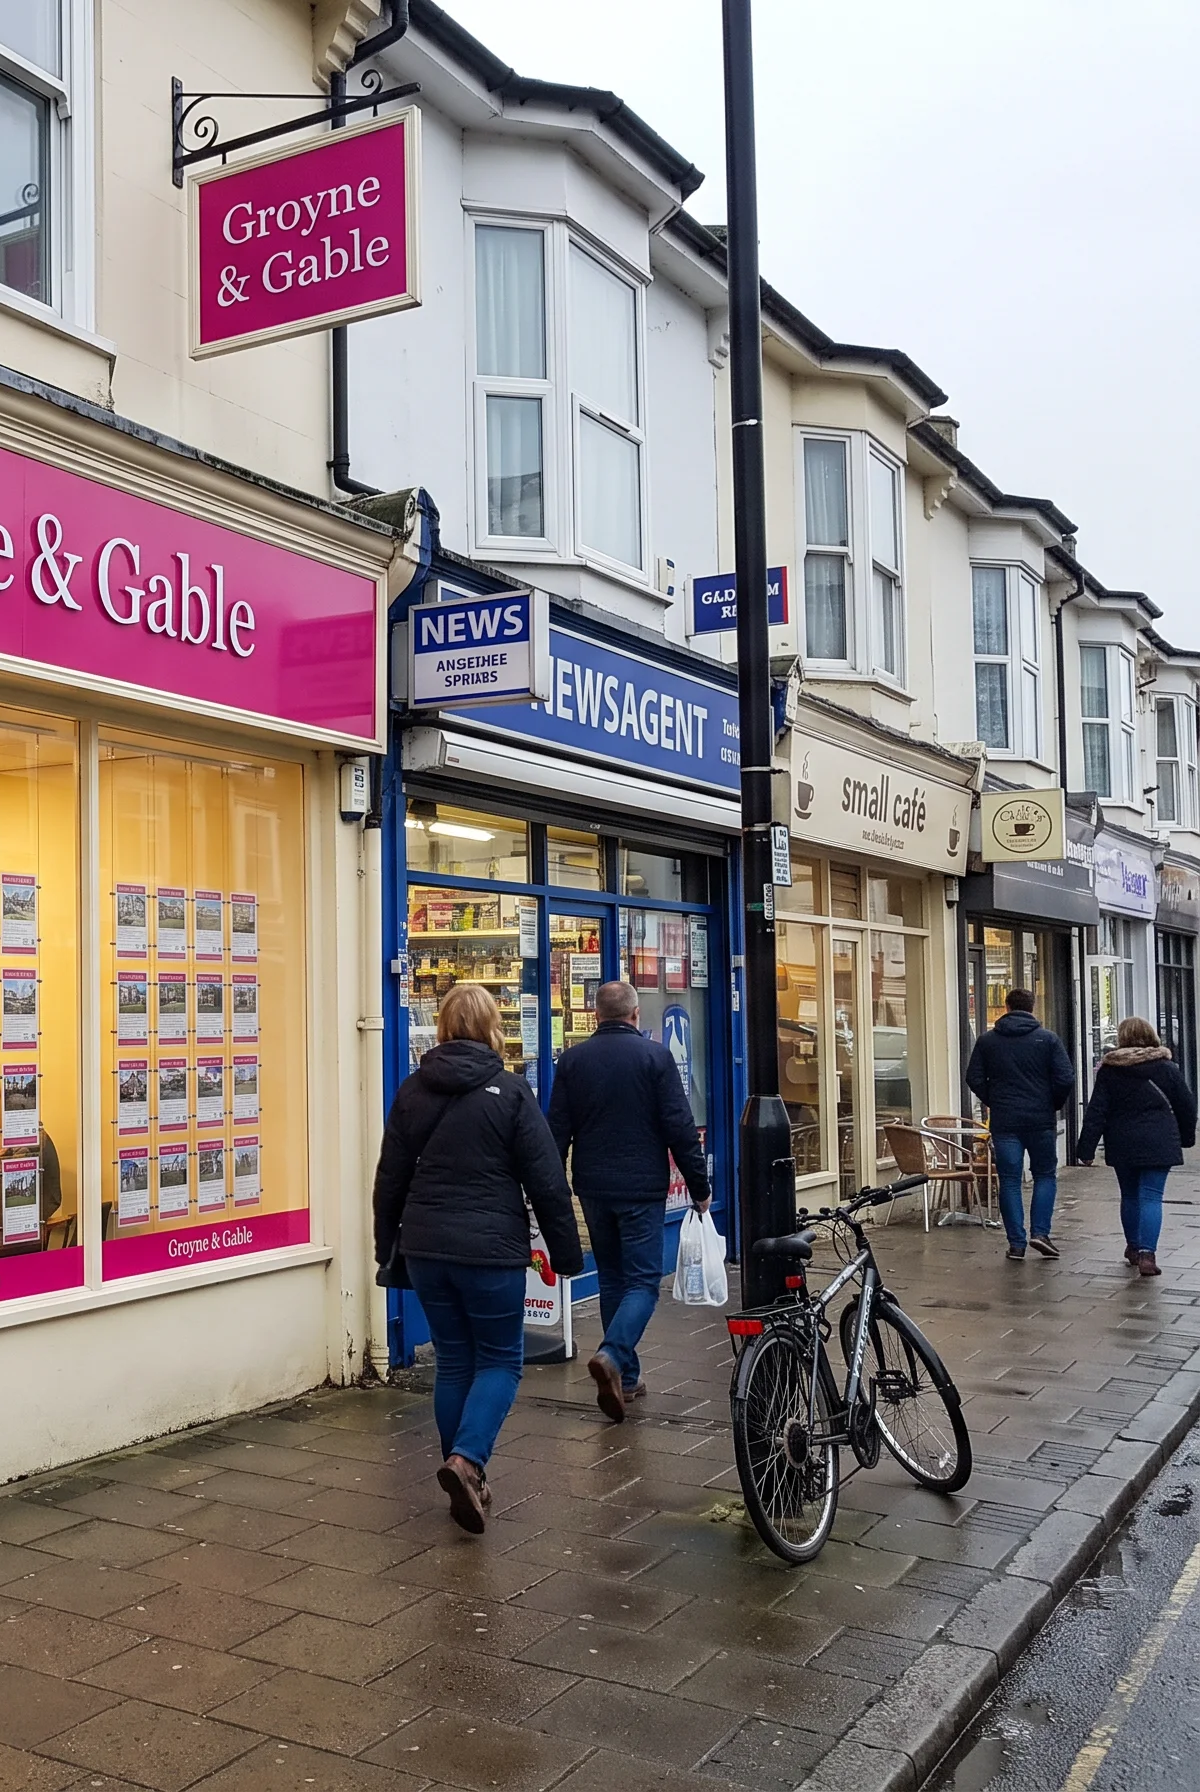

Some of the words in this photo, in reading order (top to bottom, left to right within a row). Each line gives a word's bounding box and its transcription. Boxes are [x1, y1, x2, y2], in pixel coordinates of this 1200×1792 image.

[222, 176, 381, 244] Groyne
[217, 265, 251, 307] &
[262, 227, 390, 294] Gable
[30, 512, 84, 611] &
[97, 536, 257, 659] Gable
[421, 604, 524, 646] NEWS
[841, 773, 890, 823] small
[893, 787, 926, 833] café
[168, 1238, 209, 1258] Groyne
[211, 1231, 221, 1250] &
[222, 1225, 253, 1248] Gable
